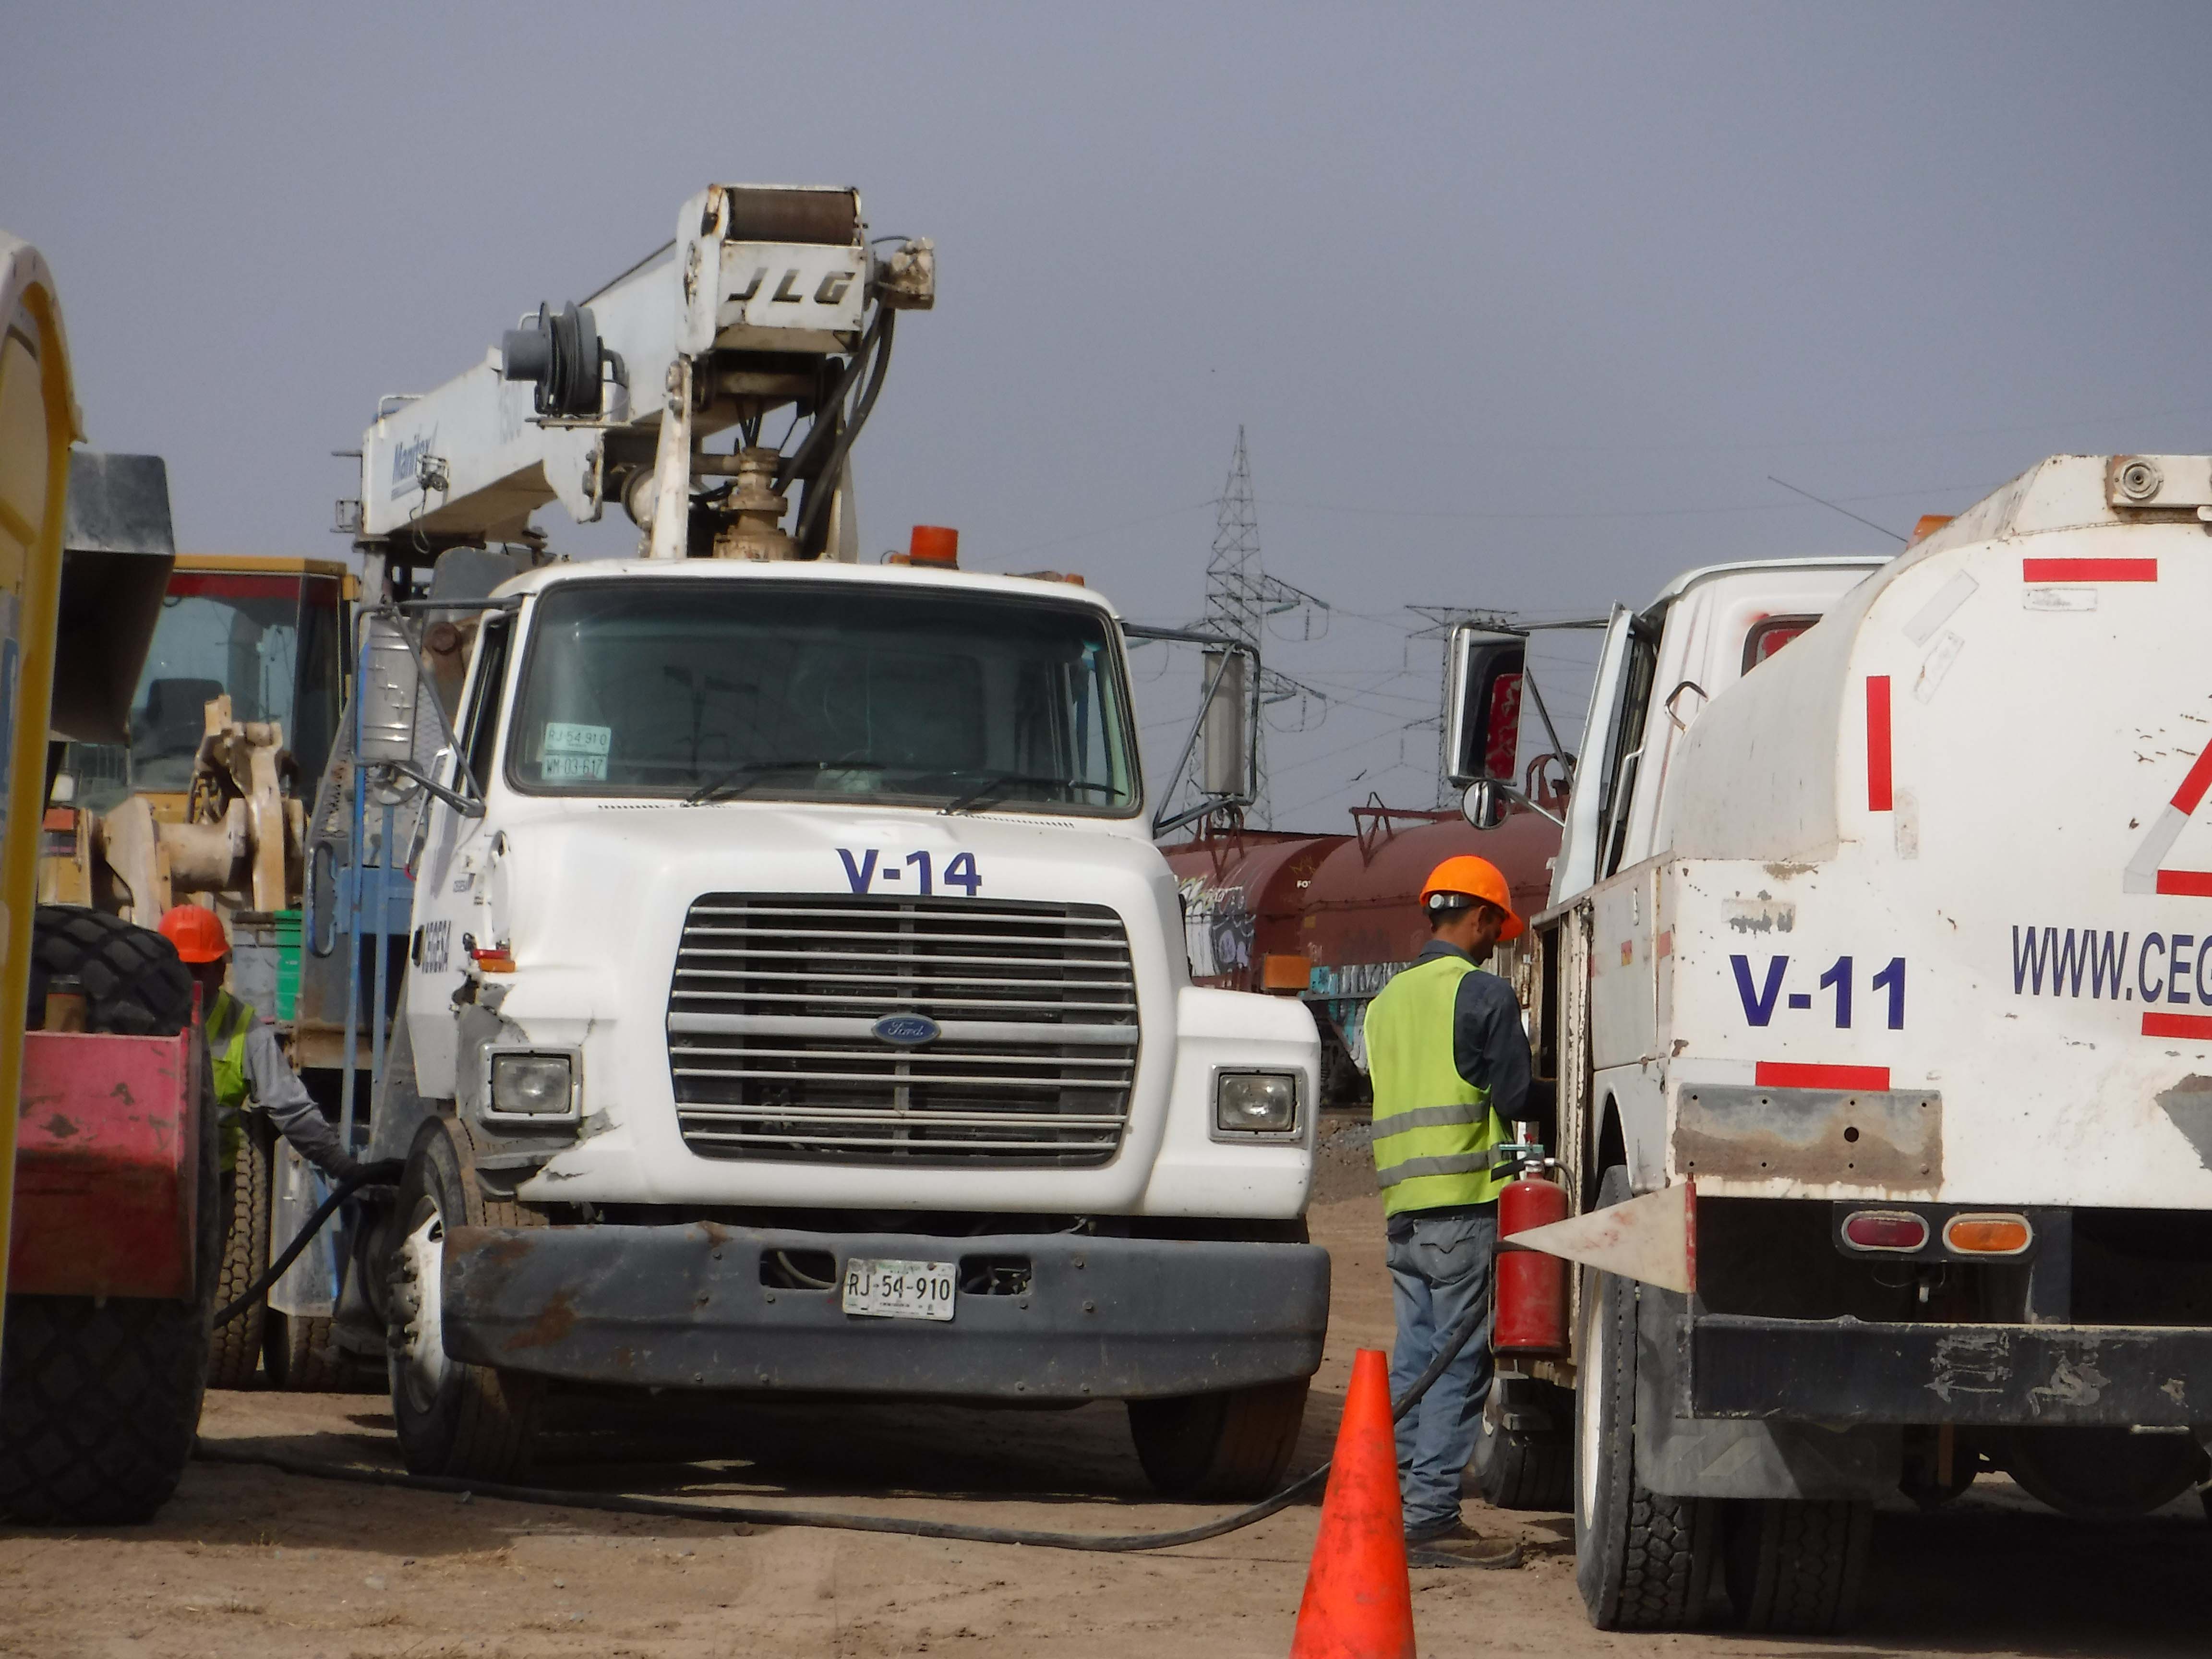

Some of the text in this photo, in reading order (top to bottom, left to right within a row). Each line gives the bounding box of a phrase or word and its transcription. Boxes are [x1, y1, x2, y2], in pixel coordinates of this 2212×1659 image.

[725, 267, 855, 305] JLG
[836, 849, 982, 896] V-14
[1730, 955, 1906, 1030] V-11
[888, 1022, 924, 1035] Ford
[849, 1273, 950, 1300] RJ-54-910
